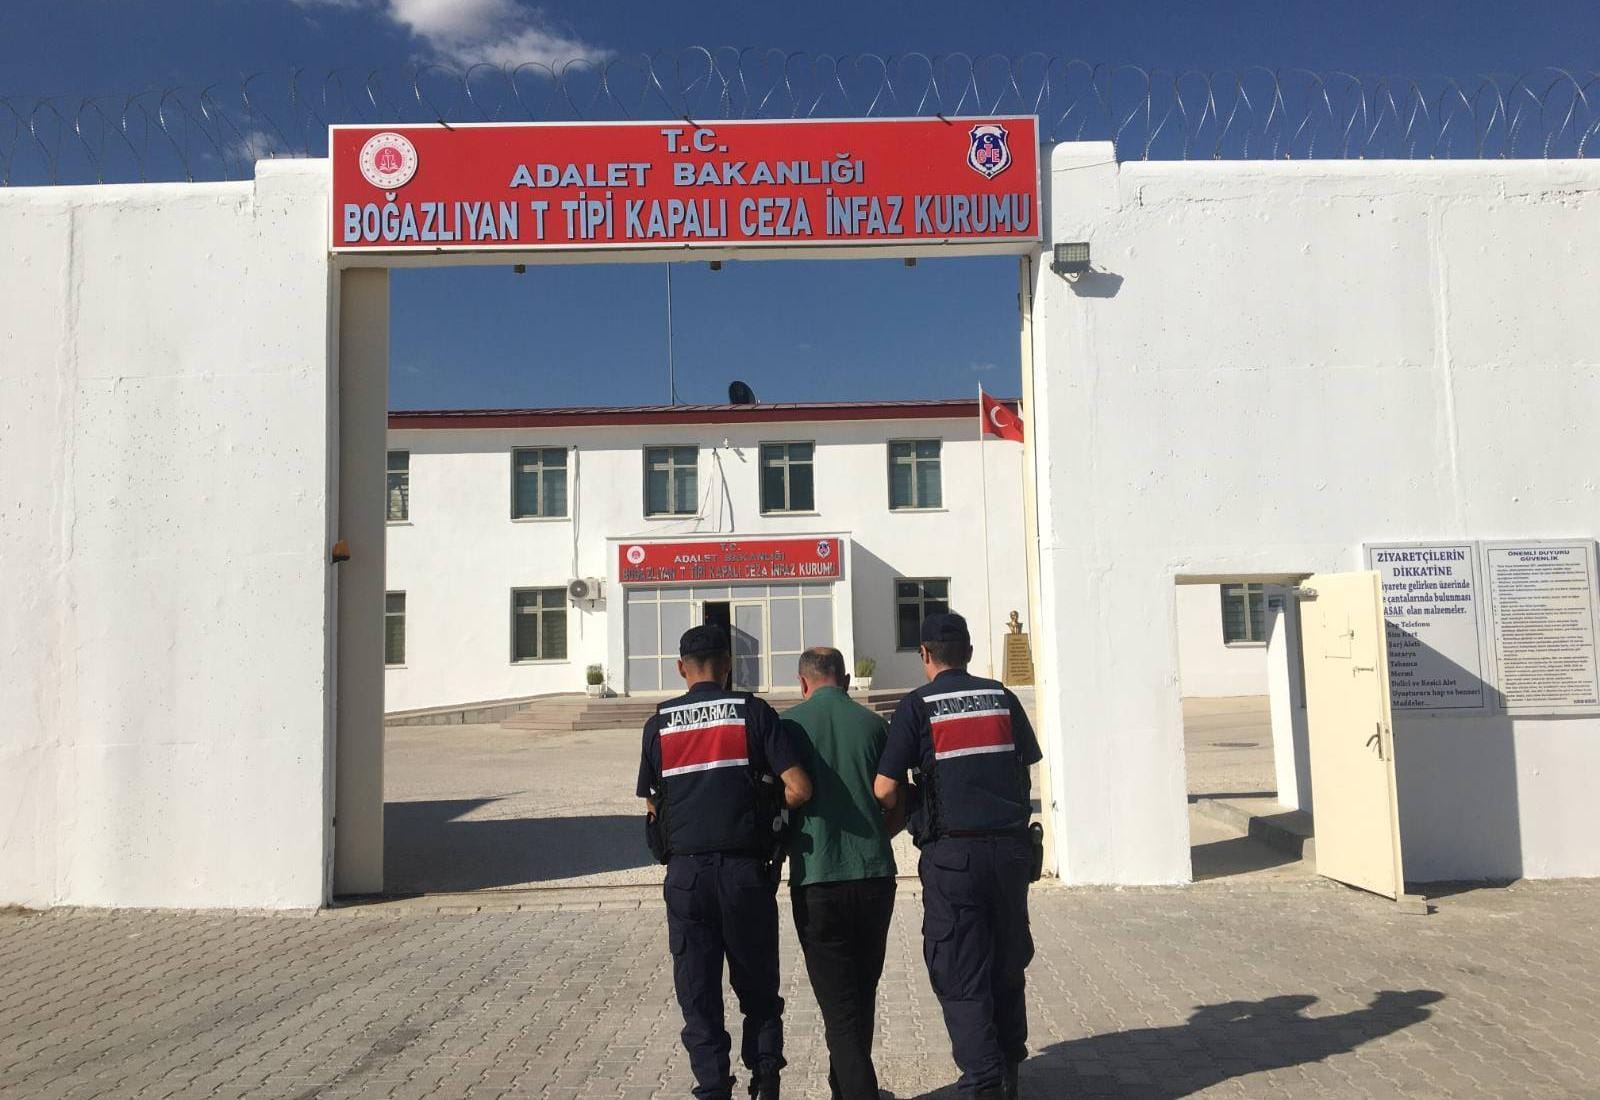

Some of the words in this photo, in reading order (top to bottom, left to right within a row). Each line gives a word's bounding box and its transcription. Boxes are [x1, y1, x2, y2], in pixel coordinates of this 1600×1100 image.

[661, 128, 728, 152] T.C.
[509, 162, 652, 188] ADALET
[673, 152, 864, 186] BAKANLIĞI
[343, 192, 518, 242] BOĞAZLIYAN
[531, 200, 549, 240] T
[561, 191, 613, 239] TİPİ
[625, 198, 728, 238] KAPALI
[739, 197, 812, 236] CEZA
[826, 188, 904, 235] İNFAZ
[915, 193, 1031, 233] KURUMU
[674, 553, 718, 563] ADALET
[1377, 549, 1465, 564] ZİYARETÇİLERİN
[744, 563, 768, 577] CEZA
[800, 562, 835, 576] KURUMU
[1393, 564, 1453, 577] DİKKATİNE
[1382, 581, 1407, 593] iyarete
[1408, 580, 1437, 592] gelirken
[1439, 579, 1470, 589] üzerinde
[1387, 593, 1434, 604] çantalarında
[1434, 592, 1471, 601] bulunması
[1384, 605, 1404, 615] ASAK
[1407, 605, 1422, 615] olan
[934, 694, 1001, 716] JANDARMA
[667, 703, 738, 728] JANDARMA
